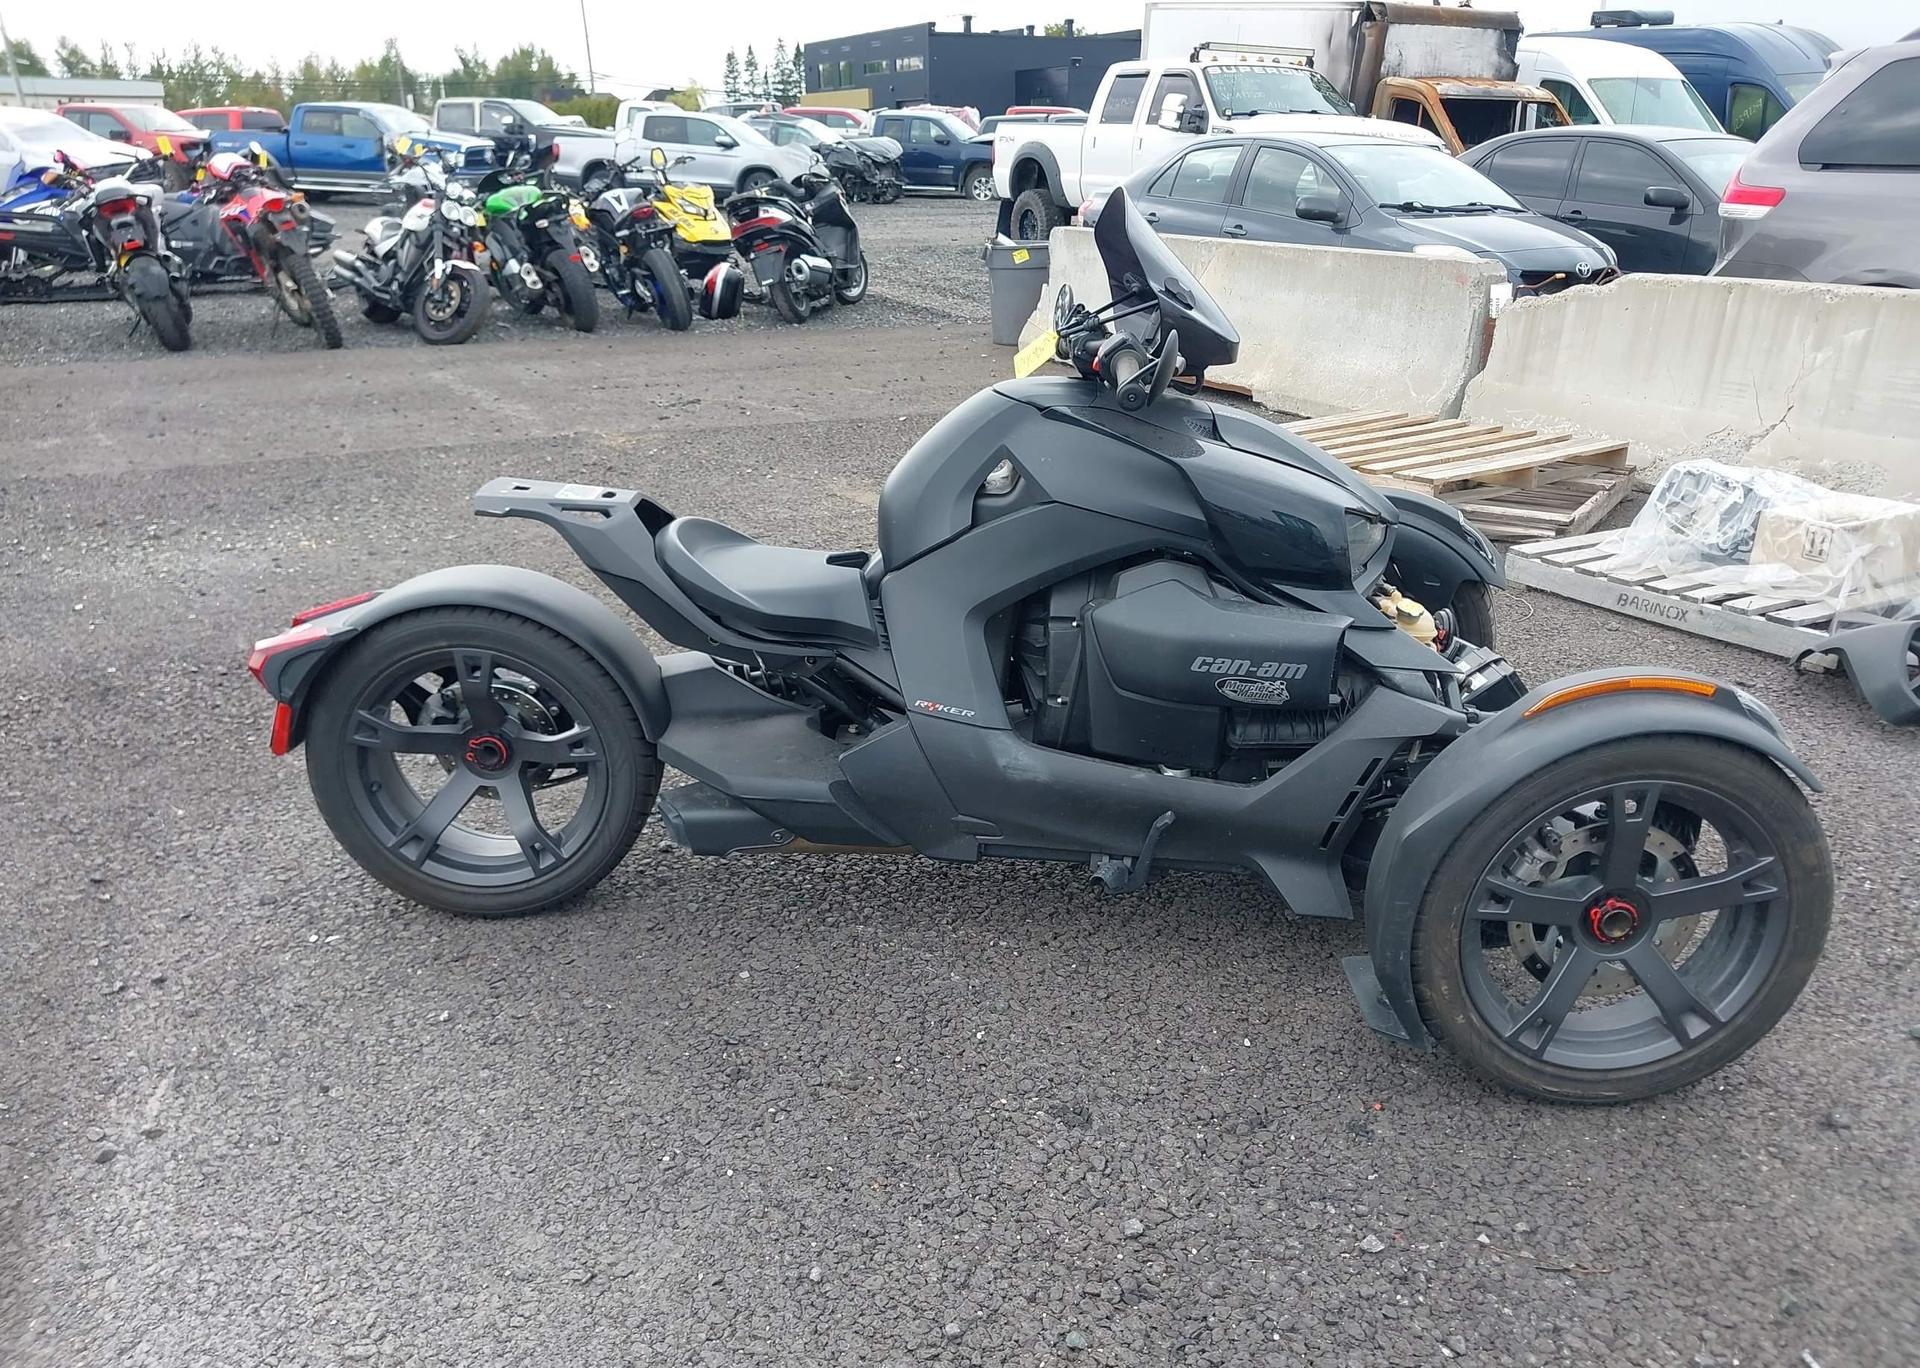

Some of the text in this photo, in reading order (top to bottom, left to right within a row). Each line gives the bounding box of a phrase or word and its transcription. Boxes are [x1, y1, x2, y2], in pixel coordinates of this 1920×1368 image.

[1617, 592, 1689, 624] BARINOX
[1224, 680, 1272, 693] Mercier
[1236, 689, 1278, 700] Marine
[914, 700, 976, 717] RYKER
